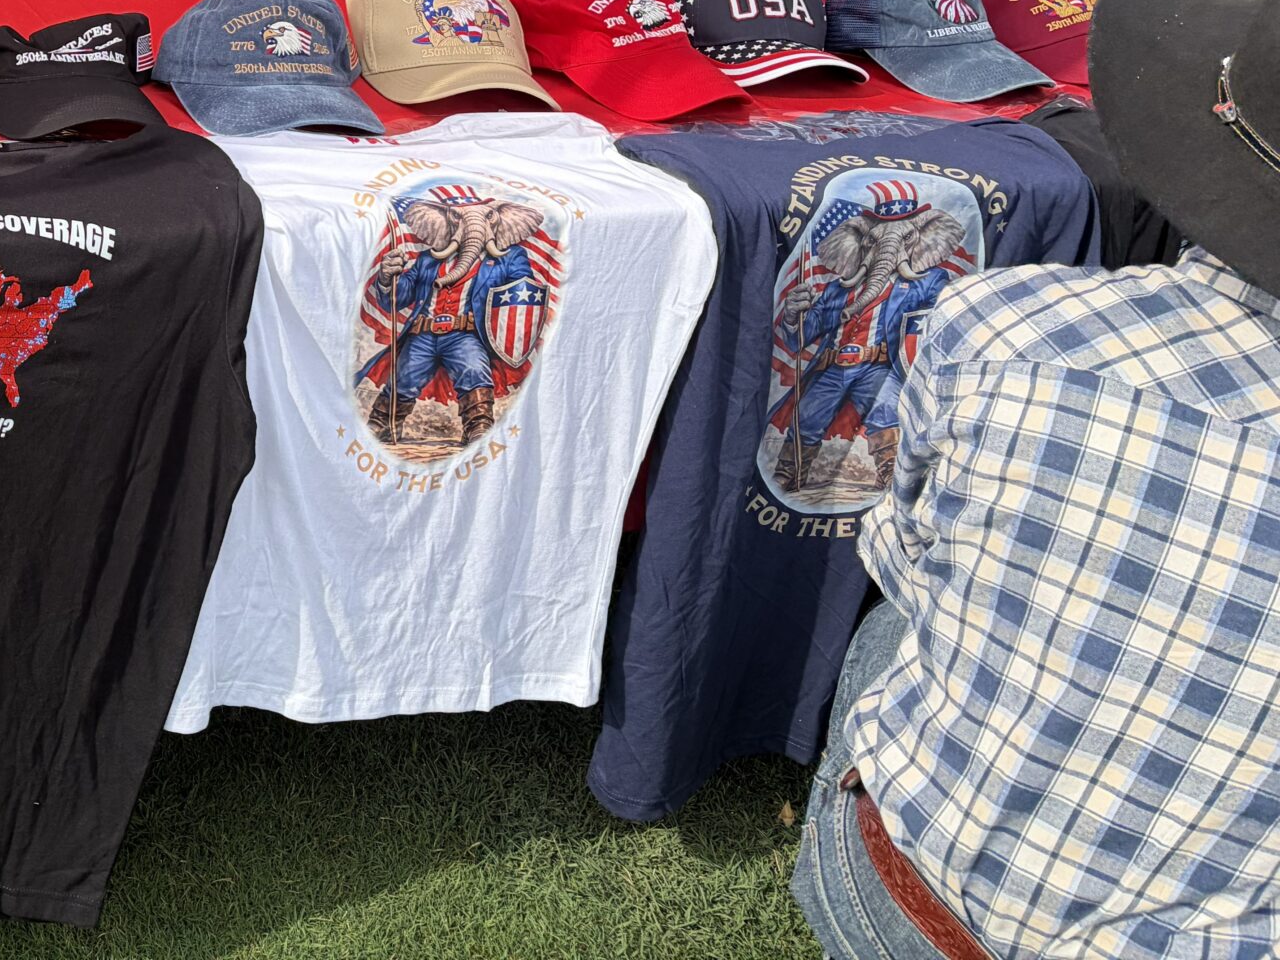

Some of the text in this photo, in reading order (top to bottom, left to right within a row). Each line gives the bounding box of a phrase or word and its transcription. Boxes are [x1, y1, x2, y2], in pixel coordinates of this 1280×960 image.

[1030, 3, 1049, 16] 1776
[222, 5, 282, 35] UNITED
[1046, 17, 1072, 32] 250TH
[230, 40, 256, 52] 1776
[612, 31, 644, 48] 250th
[16, 51, 49, 66] 250th
[234, 62, 266, 74] 250th
[780, 154, 1008, 238] STANDING STRONG
[345, 438, 508, 493] FOR THE USA
[745, 494, 856, 538] FOR THE
